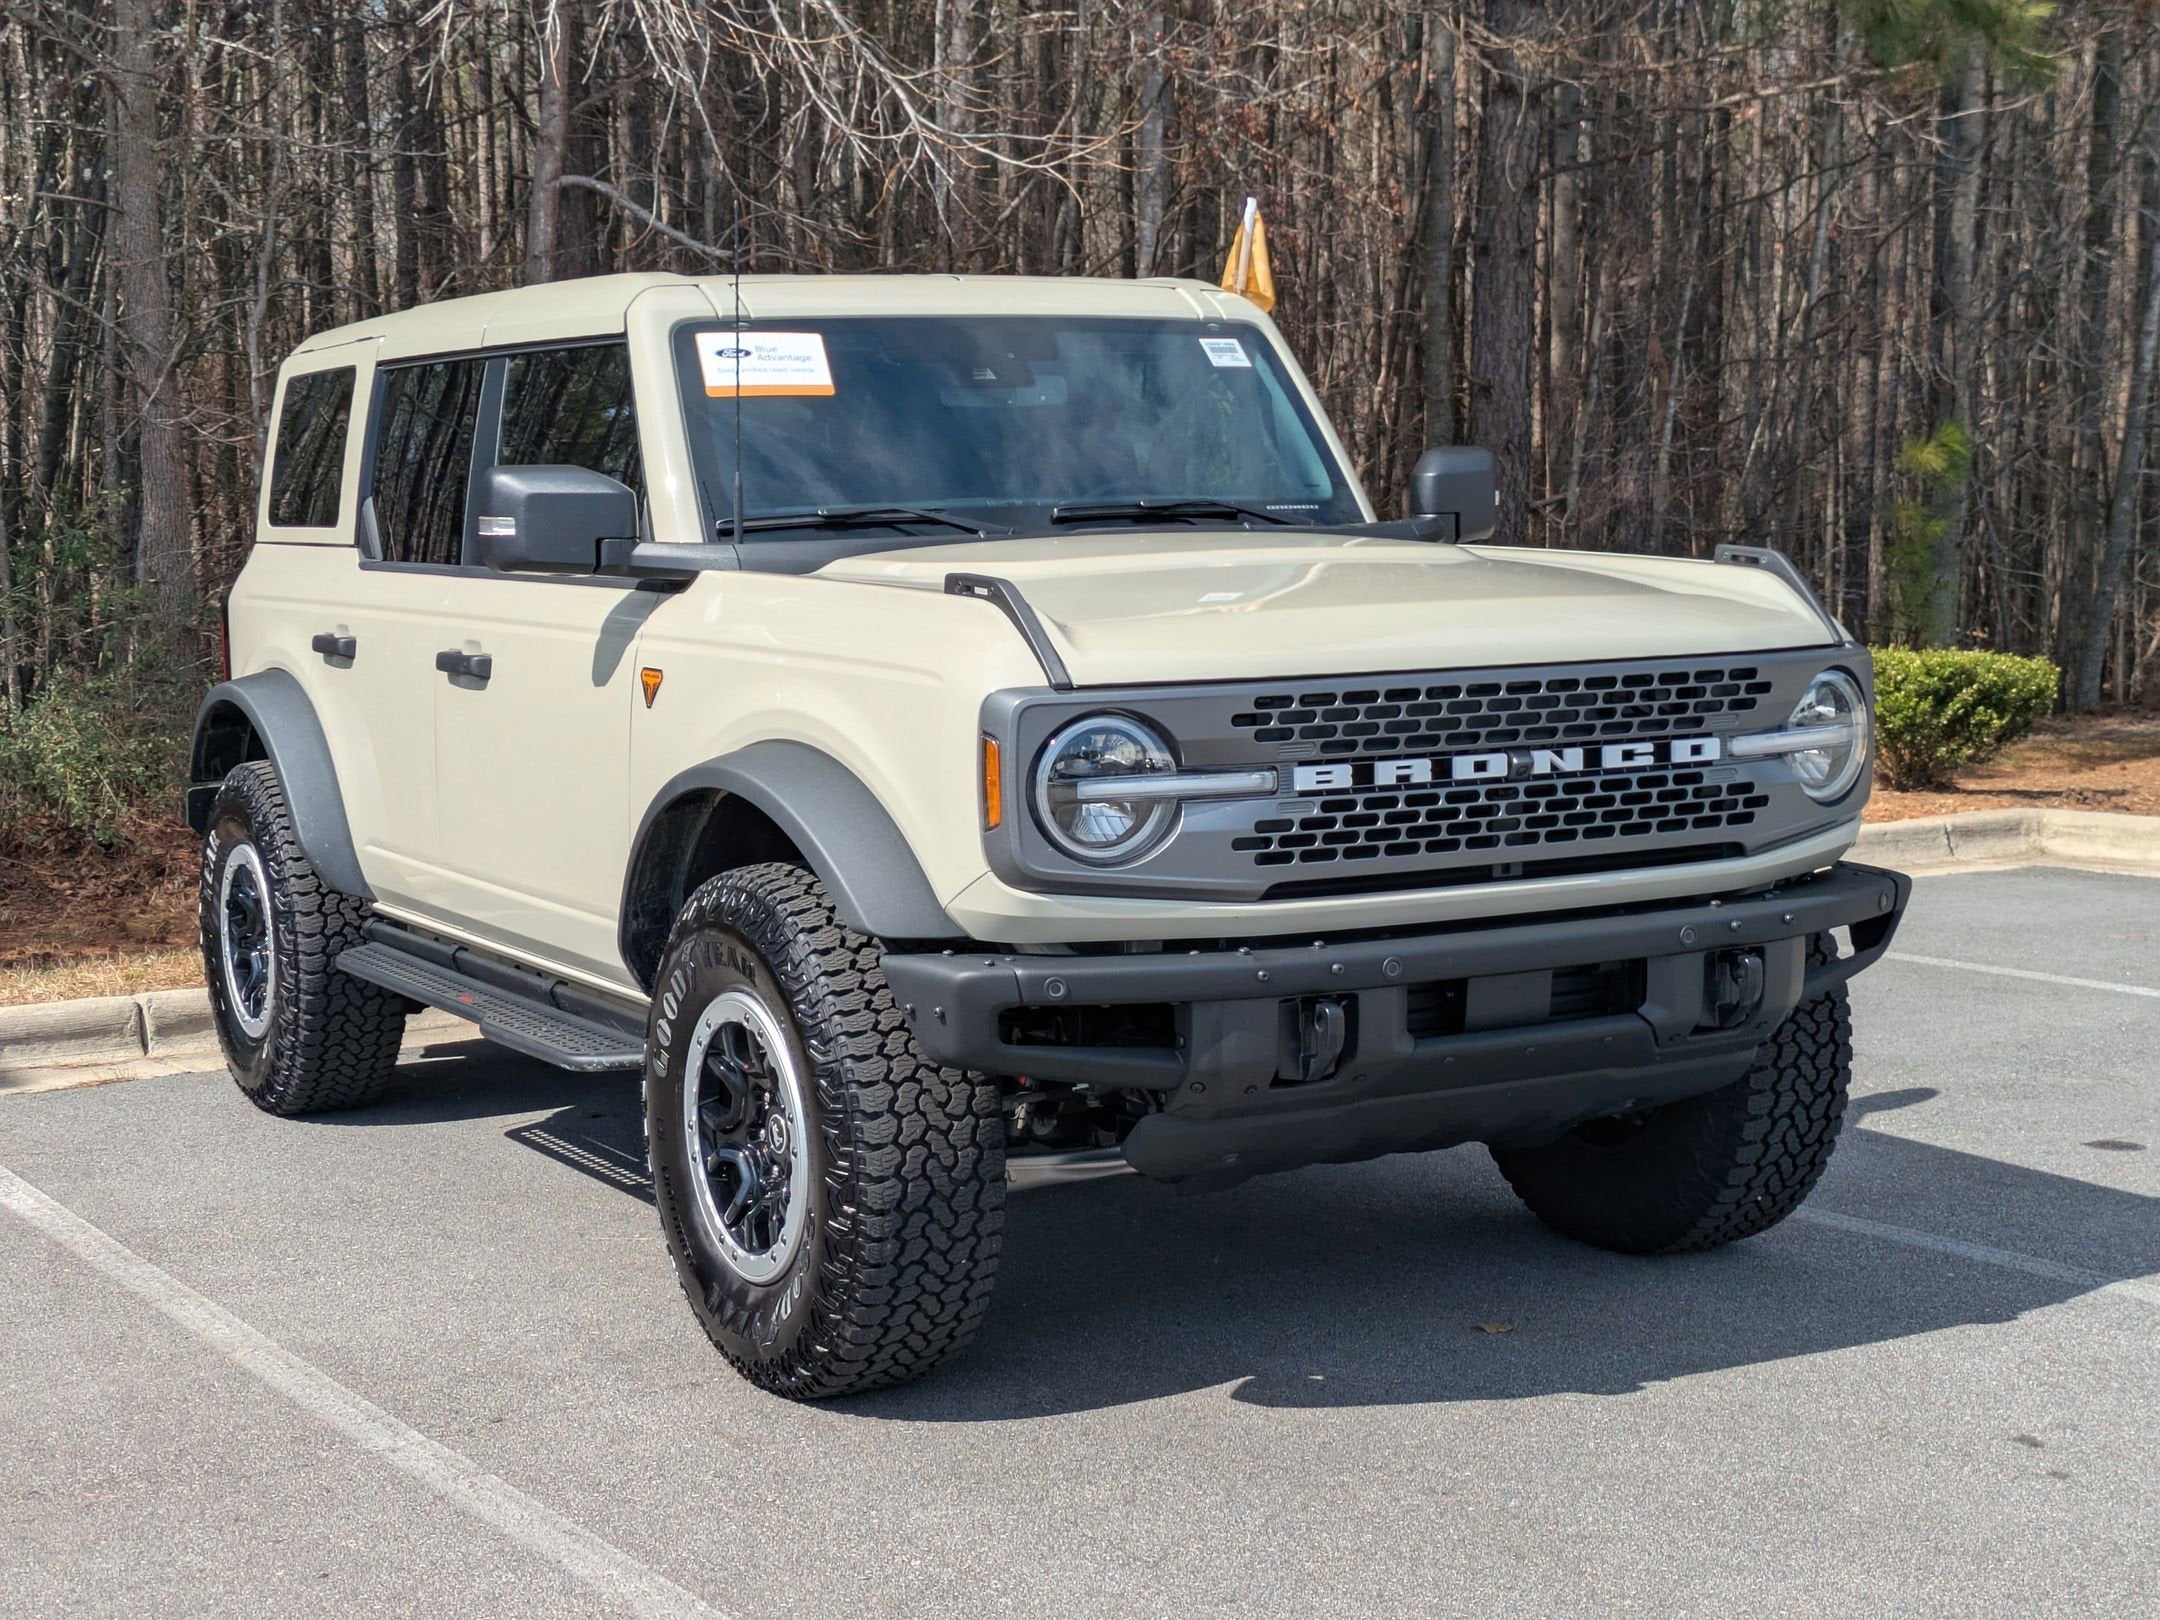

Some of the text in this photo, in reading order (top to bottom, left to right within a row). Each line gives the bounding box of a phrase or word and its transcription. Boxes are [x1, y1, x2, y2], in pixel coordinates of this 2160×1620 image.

[755, 345, 778, 353] Blue
[757, 353, 812, 363] Advantage
[1294, 737, 1721, 791] BRONCO
